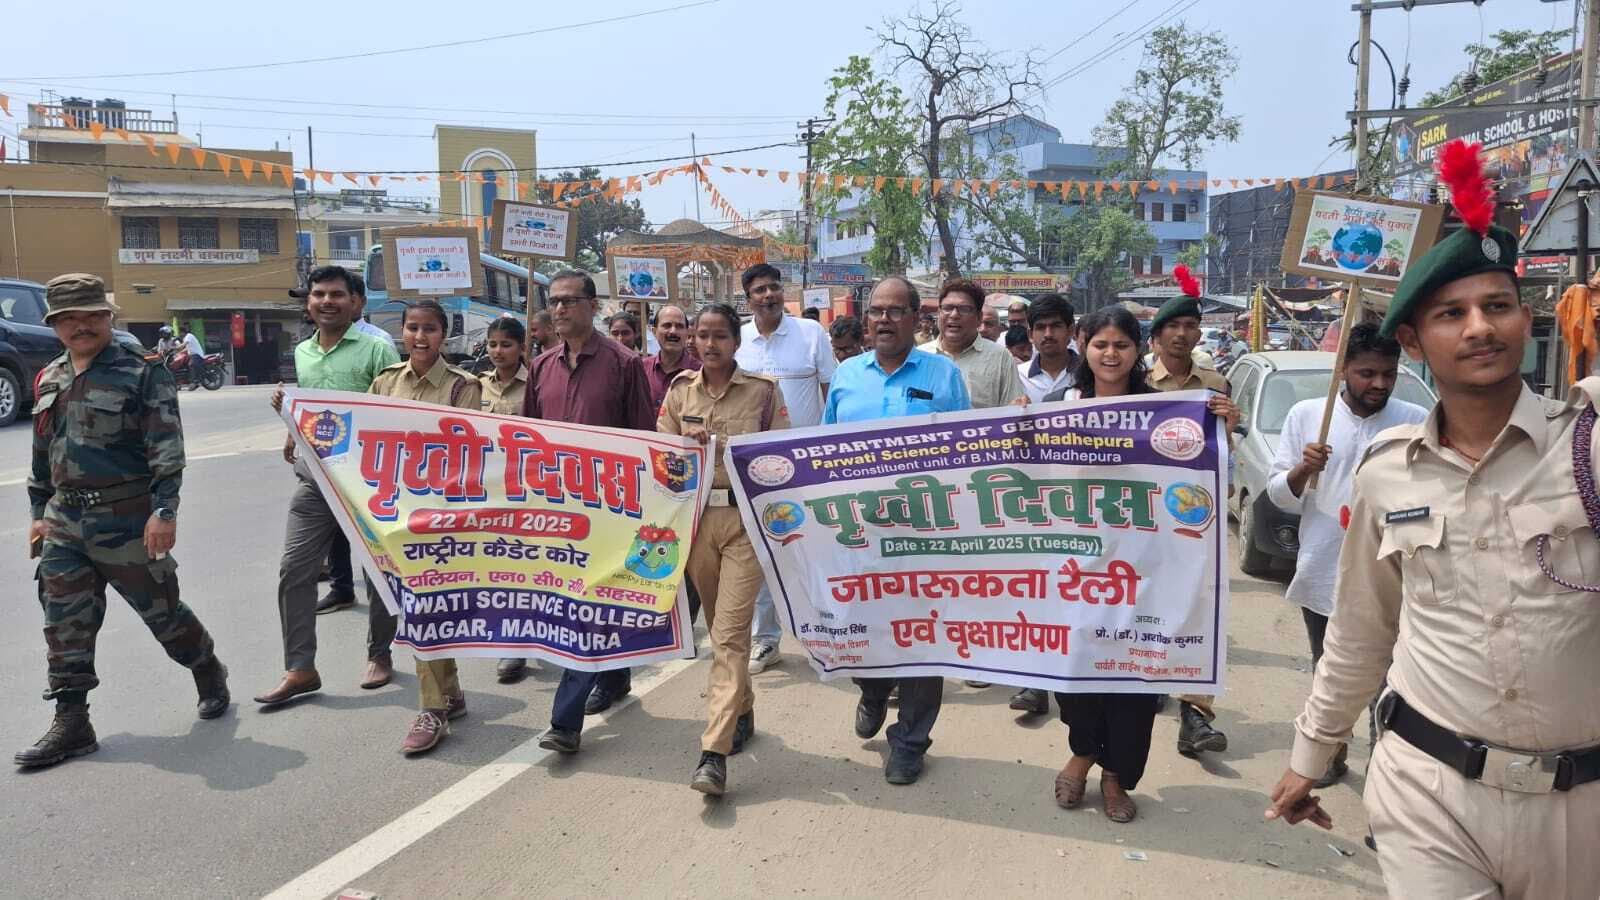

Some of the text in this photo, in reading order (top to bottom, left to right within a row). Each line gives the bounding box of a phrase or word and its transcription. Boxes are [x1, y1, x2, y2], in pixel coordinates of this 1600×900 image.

[1420, 123, 1447, 146] SARK
[1484, 118, 1525, 142] SCHOOL
[1528, 113, 1536, 129] &
[792, 410, 1154, 460] DEPARTMENT OF GEOGRAPHY
[812, 433, 1134, 470] Parwati Science College, Madhepura
[357, 416, 646, 522] पृथ्वी दिवस
[829, 448, 1121, 479] A Constituent unit of B.N.M.U. Madhepura
[429, 512, 572, 532] 22 April 2025
[804, 468, 1162, 548] पृथ्वी दिवस
[403, 535, 477, 564] राष्ट्रीय
[483, 537, 541, 560] कैडेट
[545, 543, 590, 568] कोर
[885, 540, 917, 552] Date
[929, 540, 947, 552] 22
[951, 539, 984, 554] April
[988, 537, 1024, 550] 2025
[1028, 536, 1100, 554] (Tuesday)
[827, 558, 1142, 606] जागरूकता रैली
[401, 590, 668, 628] RWATI SCIENCE COLLEGE
[408, 618, 493, 641] NAGAR,
[502, 618, 622, 651] MADHEPURA
[800, 623, 812, 633] डॉ.
[849, 623, 868, 635] सिंह
[891, 609, 1071, 660] एवं वृक्षारोपण
[1096, 627, 1204, 648] प्रो. (डॉ.) अशोक कुमार
[1095, 659, 1116, 671] पार्वती
